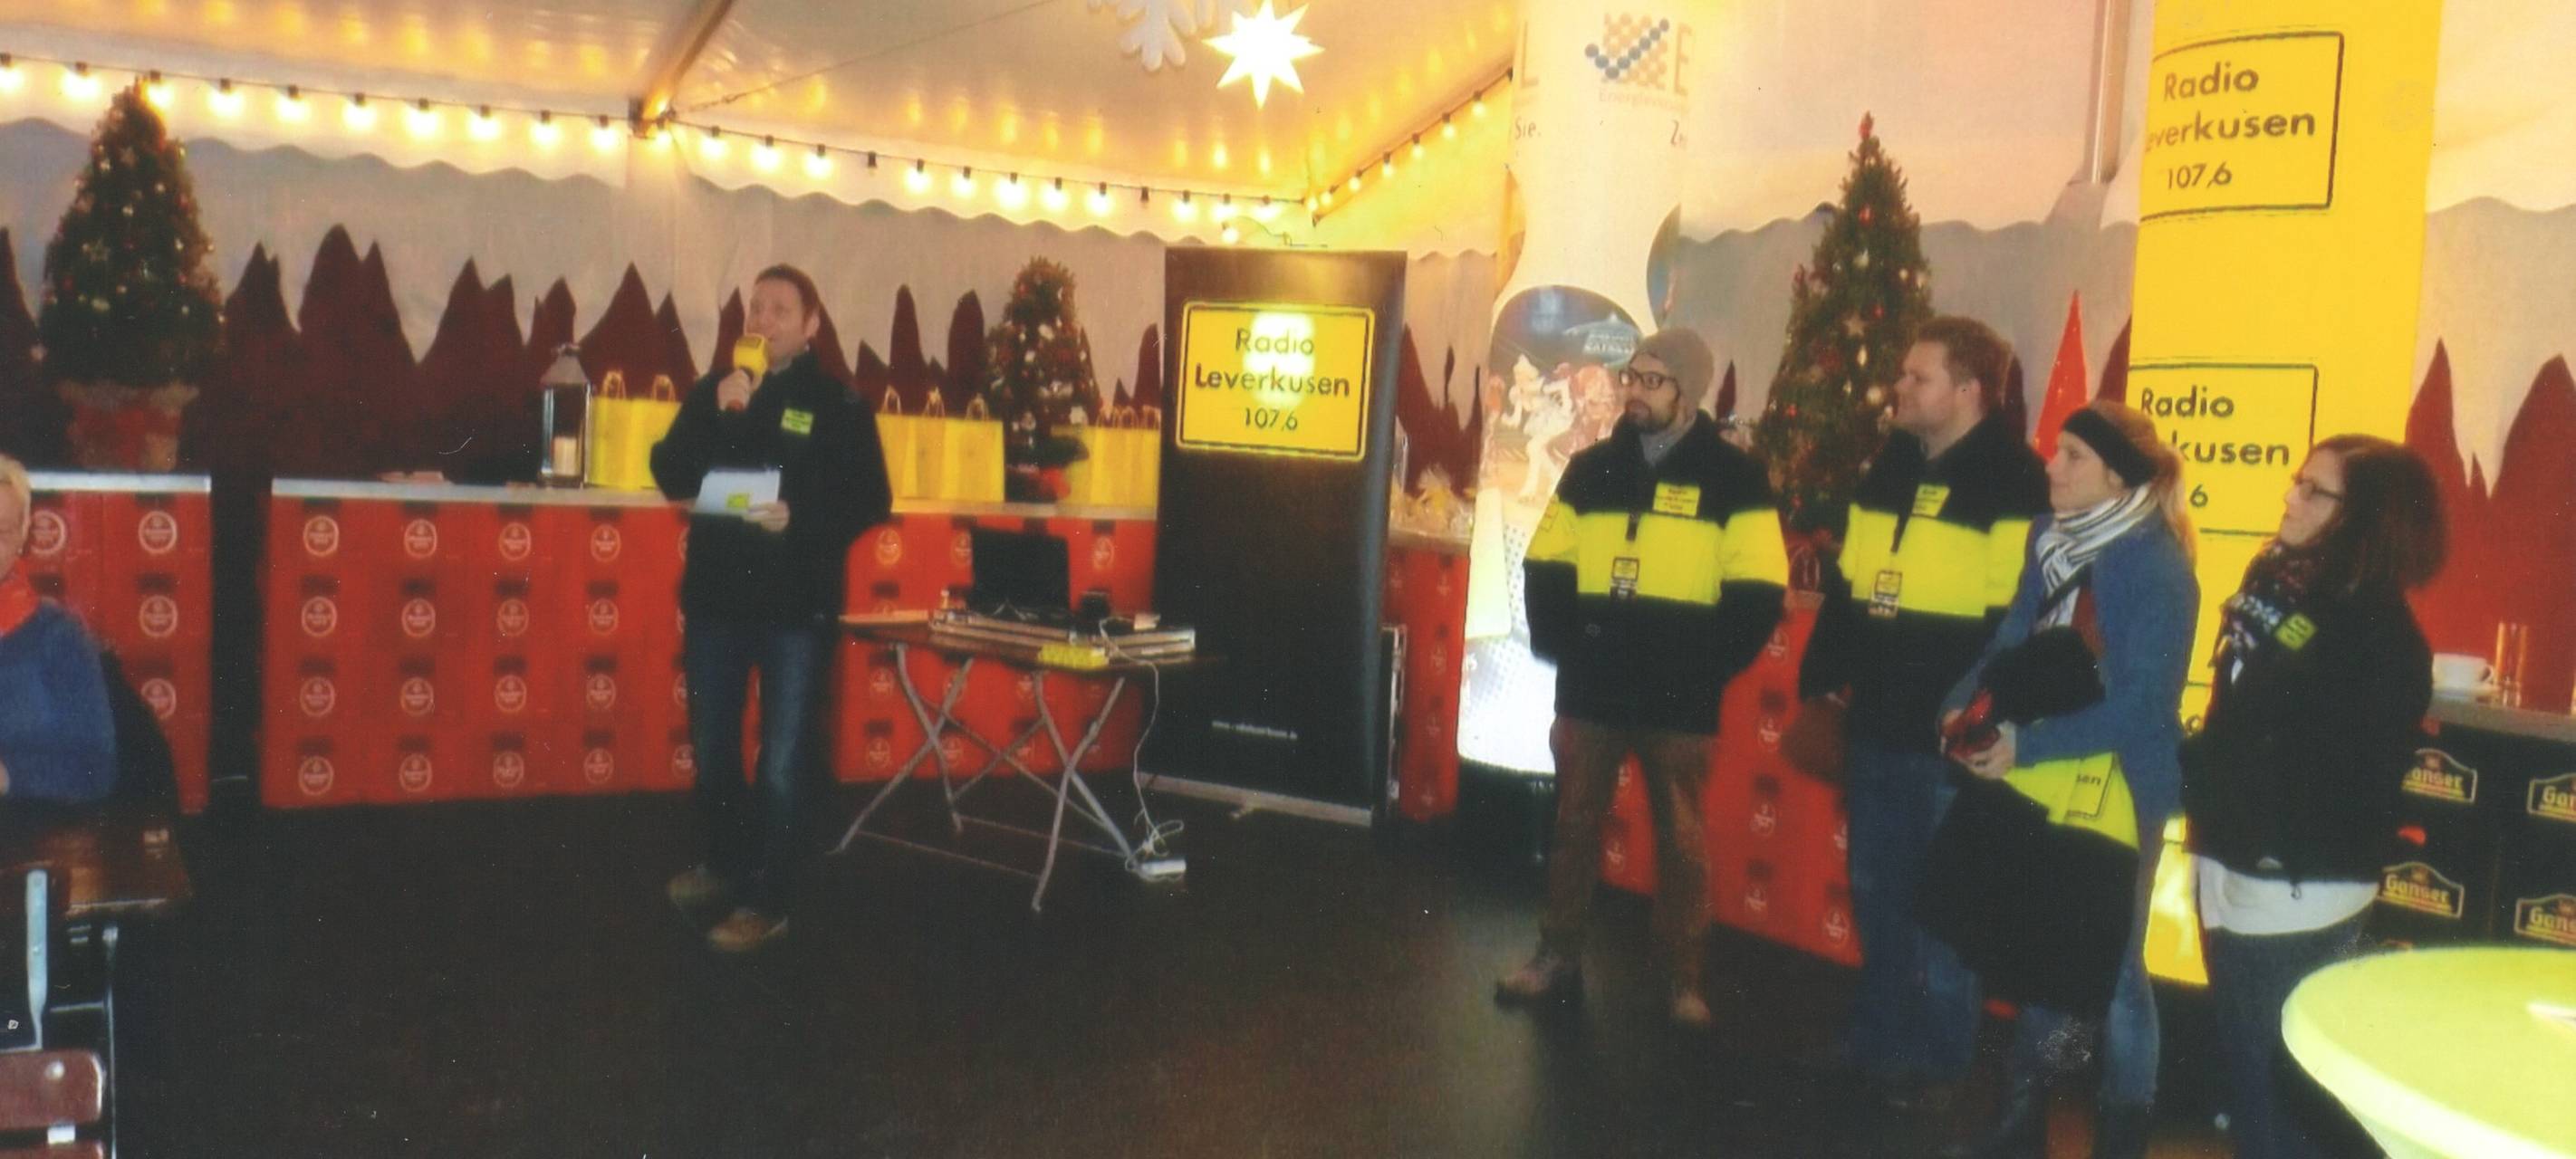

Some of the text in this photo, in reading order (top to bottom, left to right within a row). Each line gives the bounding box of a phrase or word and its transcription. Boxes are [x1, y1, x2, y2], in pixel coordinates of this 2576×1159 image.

[2163, 61, 2259, 101] Radio
[1235, 327, 1315, 355] Radio
[1195, 362, 1350, 398] Leverkusen
[2140, 386, 2234, 417] Radio
[2171, 430, 2290, 465] kusen
